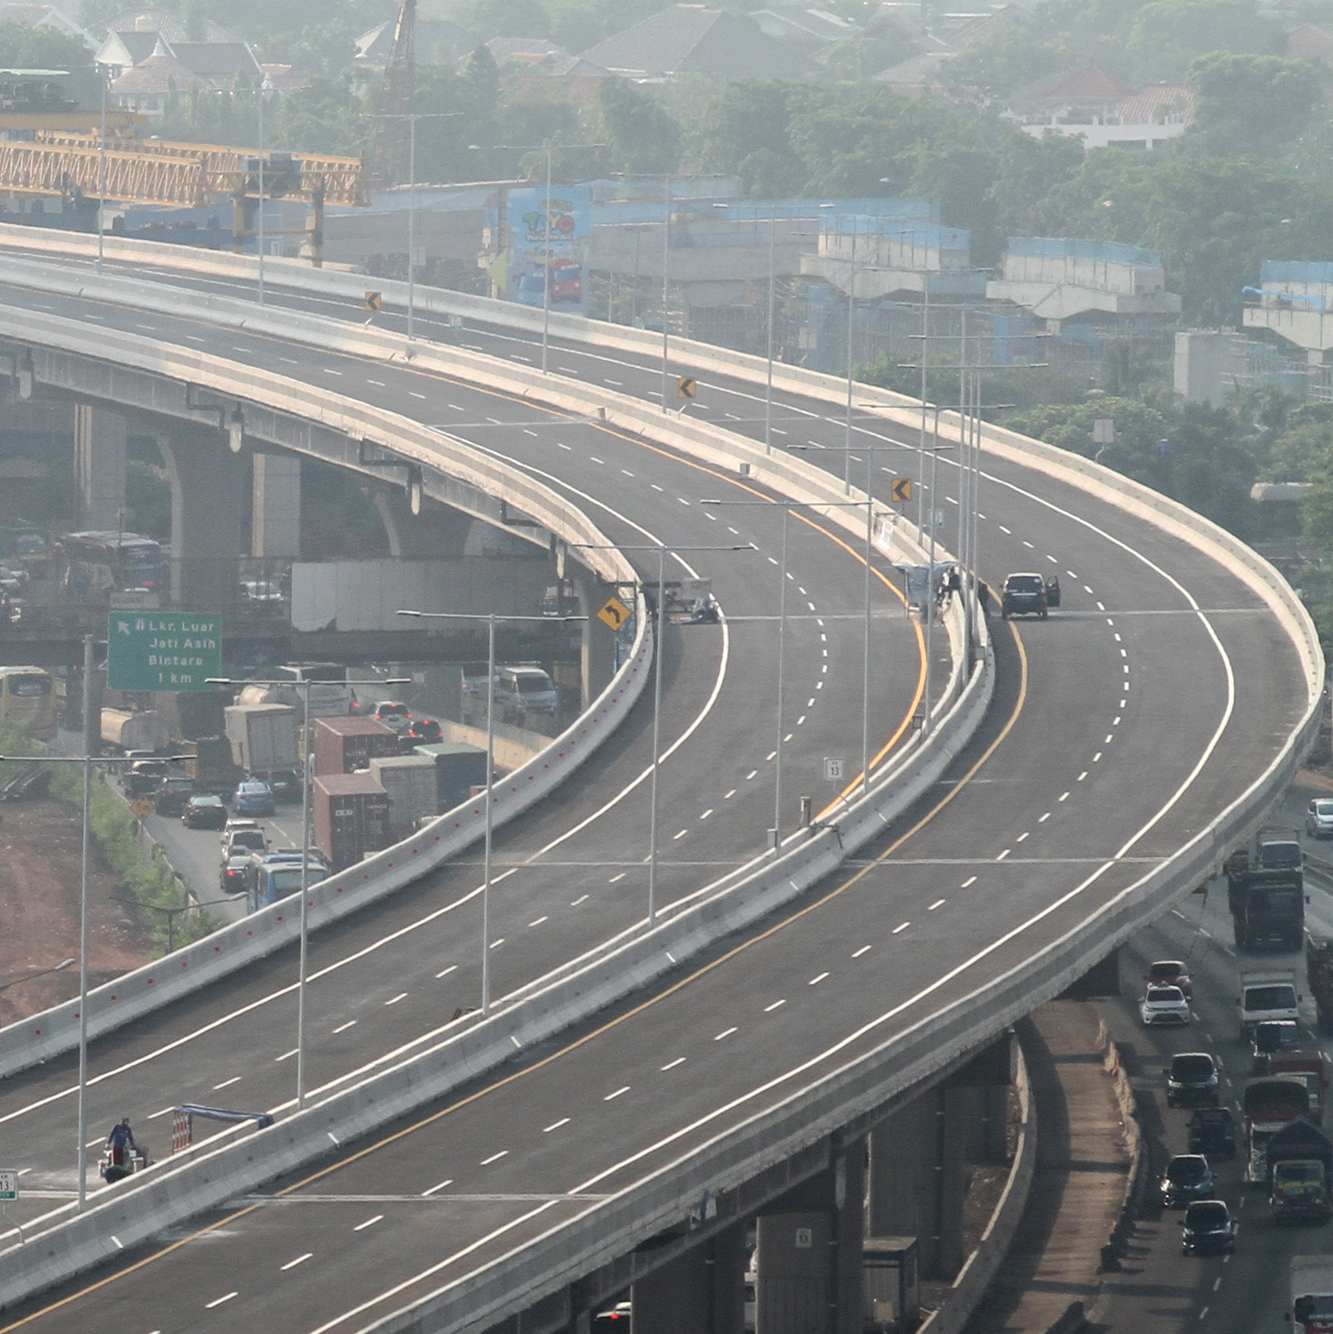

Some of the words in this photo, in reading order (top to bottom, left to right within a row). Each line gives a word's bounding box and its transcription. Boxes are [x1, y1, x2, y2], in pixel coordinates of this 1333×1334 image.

[522, 211, 575, 234] TAYO
[149, 621, 176, 632] Lkr.
[182, 622, 214, 632] Luar
[149, 638, 178, 648] Jati
[183, 638, 215, 649] Asih
[148, 655, 203, 666] Bintara
[158, 672, 163, 683] 1
[171, 672, 192, 683] km
[830, 766, 839, 776] 13
[0, 1180, 9, 1190] 13
